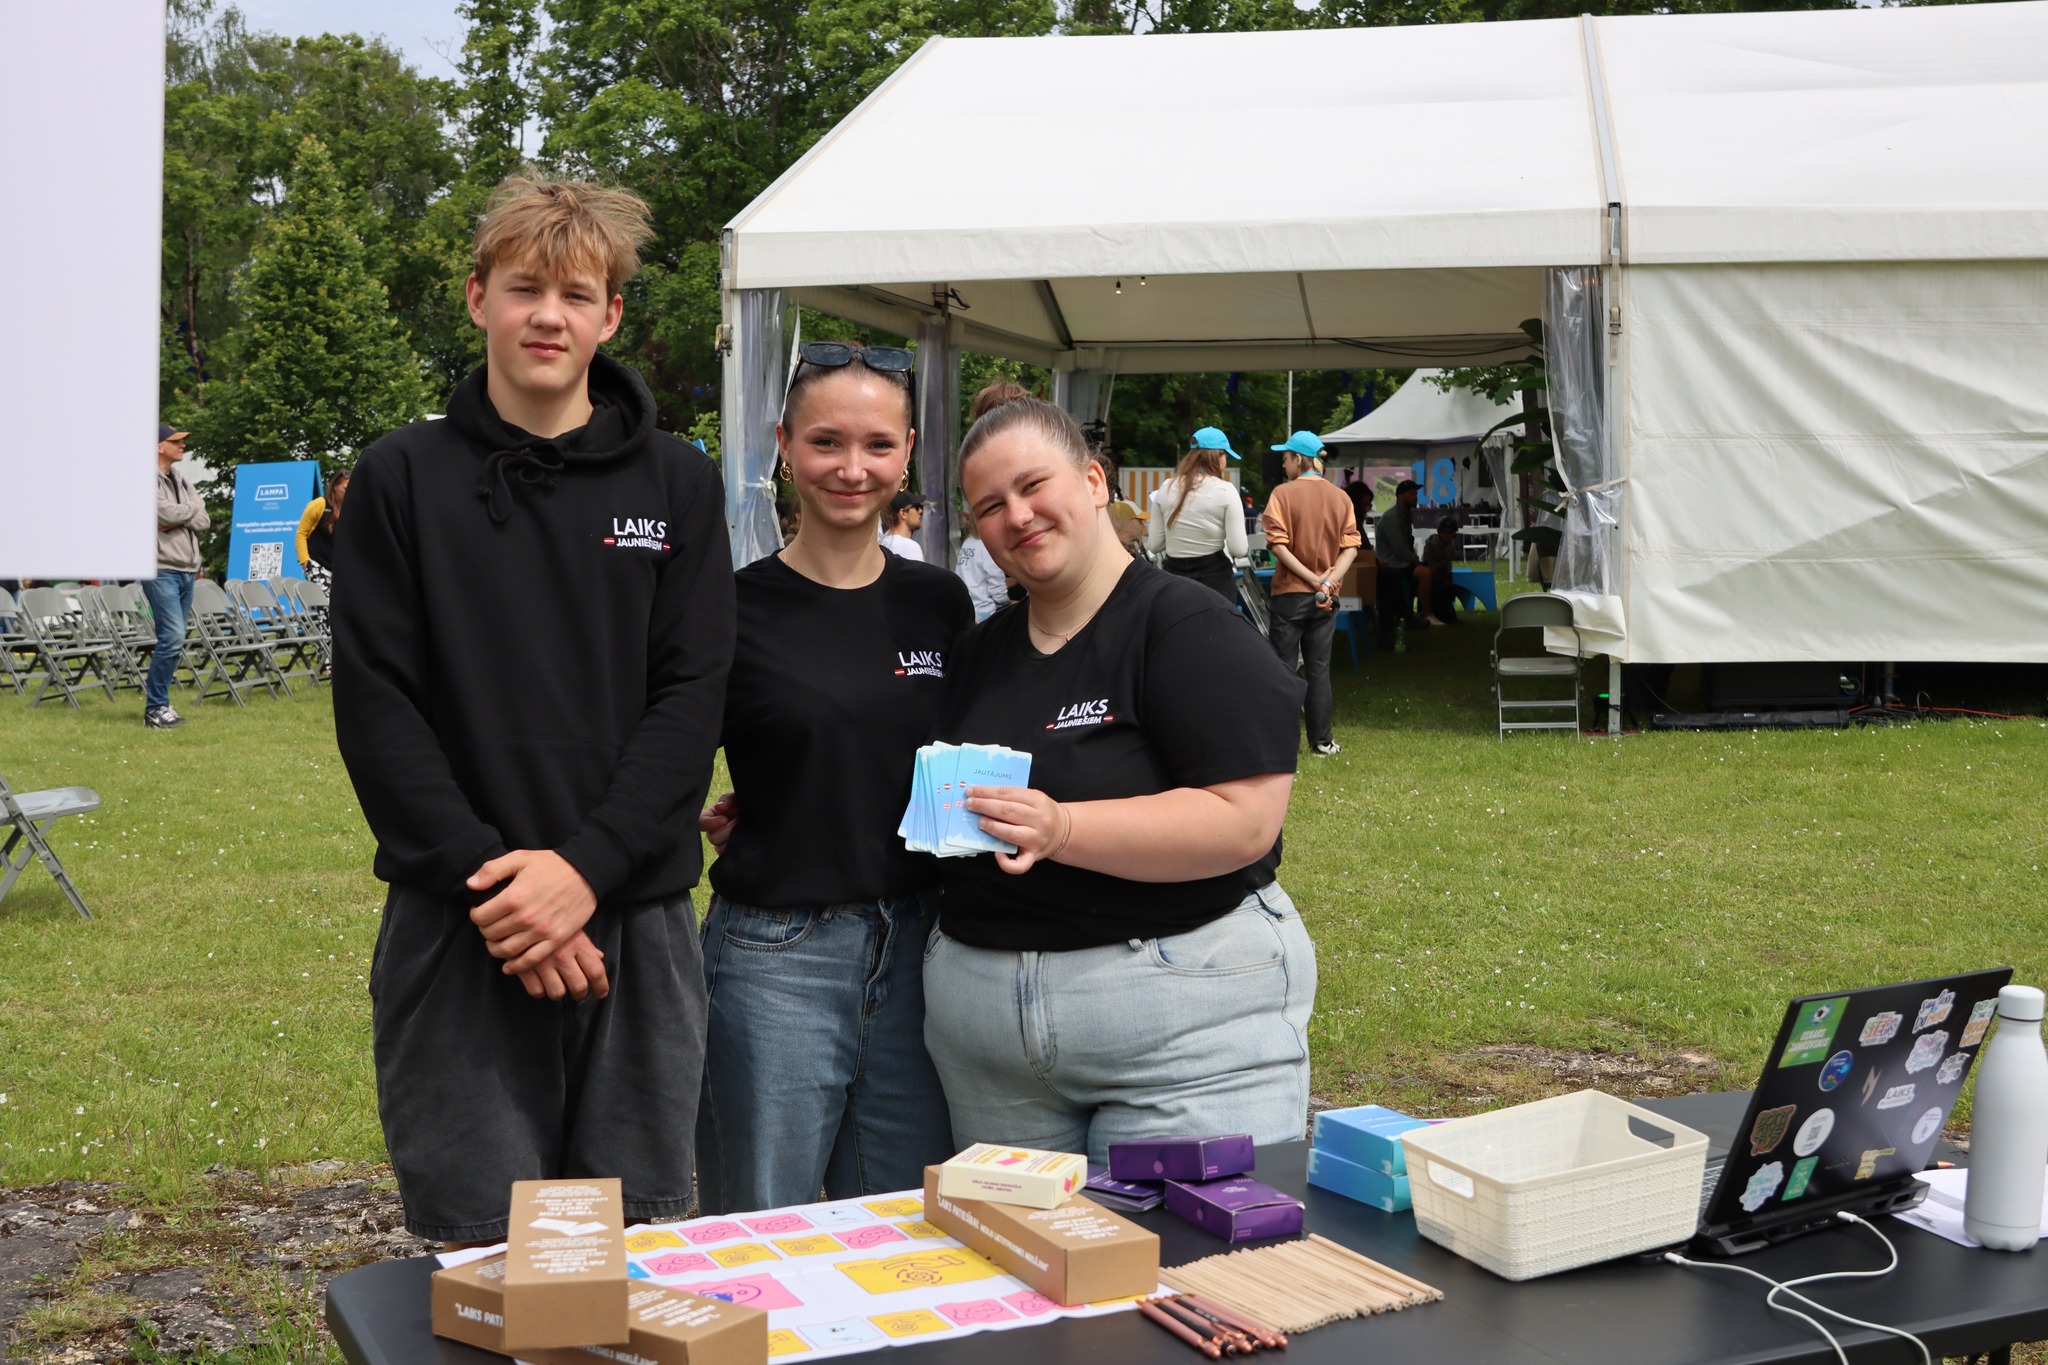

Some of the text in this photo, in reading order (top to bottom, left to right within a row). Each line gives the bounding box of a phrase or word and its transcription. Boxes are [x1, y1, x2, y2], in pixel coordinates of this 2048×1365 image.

[1411, 458, 1457, 505] 18
[260, 488, 284, 496] LAMPA
[613, 517, 667, 539] LAIKS
[898, 650, 943, 668] LAIKS
[1057, 698, 1109, 720] LAIKS
[974, 769, 1014, 780] JAUTĀJUMS
[1862, 1018, 1899, 1038] STEPS
[1886, 1086, 1913, 1100] LAIKS
